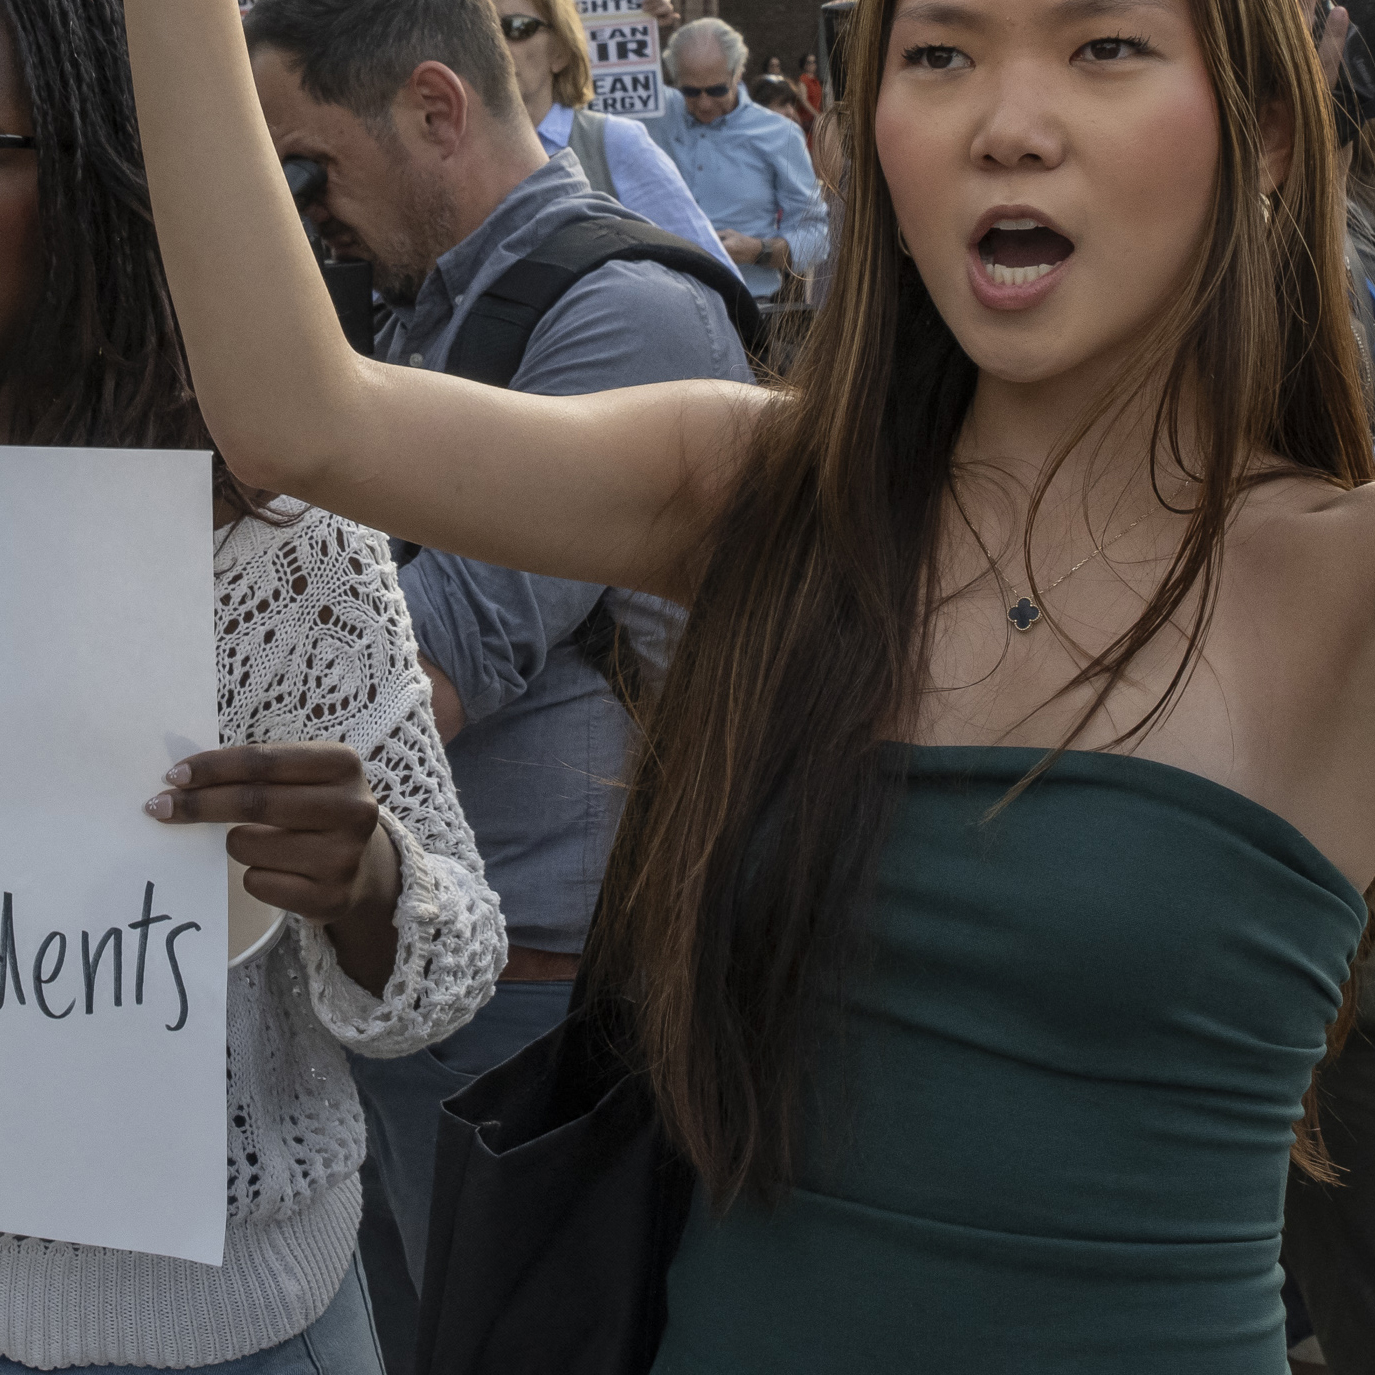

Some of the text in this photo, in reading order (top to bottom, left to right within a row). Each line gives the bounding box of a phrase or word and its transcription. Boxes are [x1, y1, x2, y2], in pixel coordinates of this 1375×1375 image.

[589, 26, 650, 42] EAN
[596, 39, 651, 62] IR
[593, 75, 652, 96] EAN
[587, 95, 653, 113] ERGY
